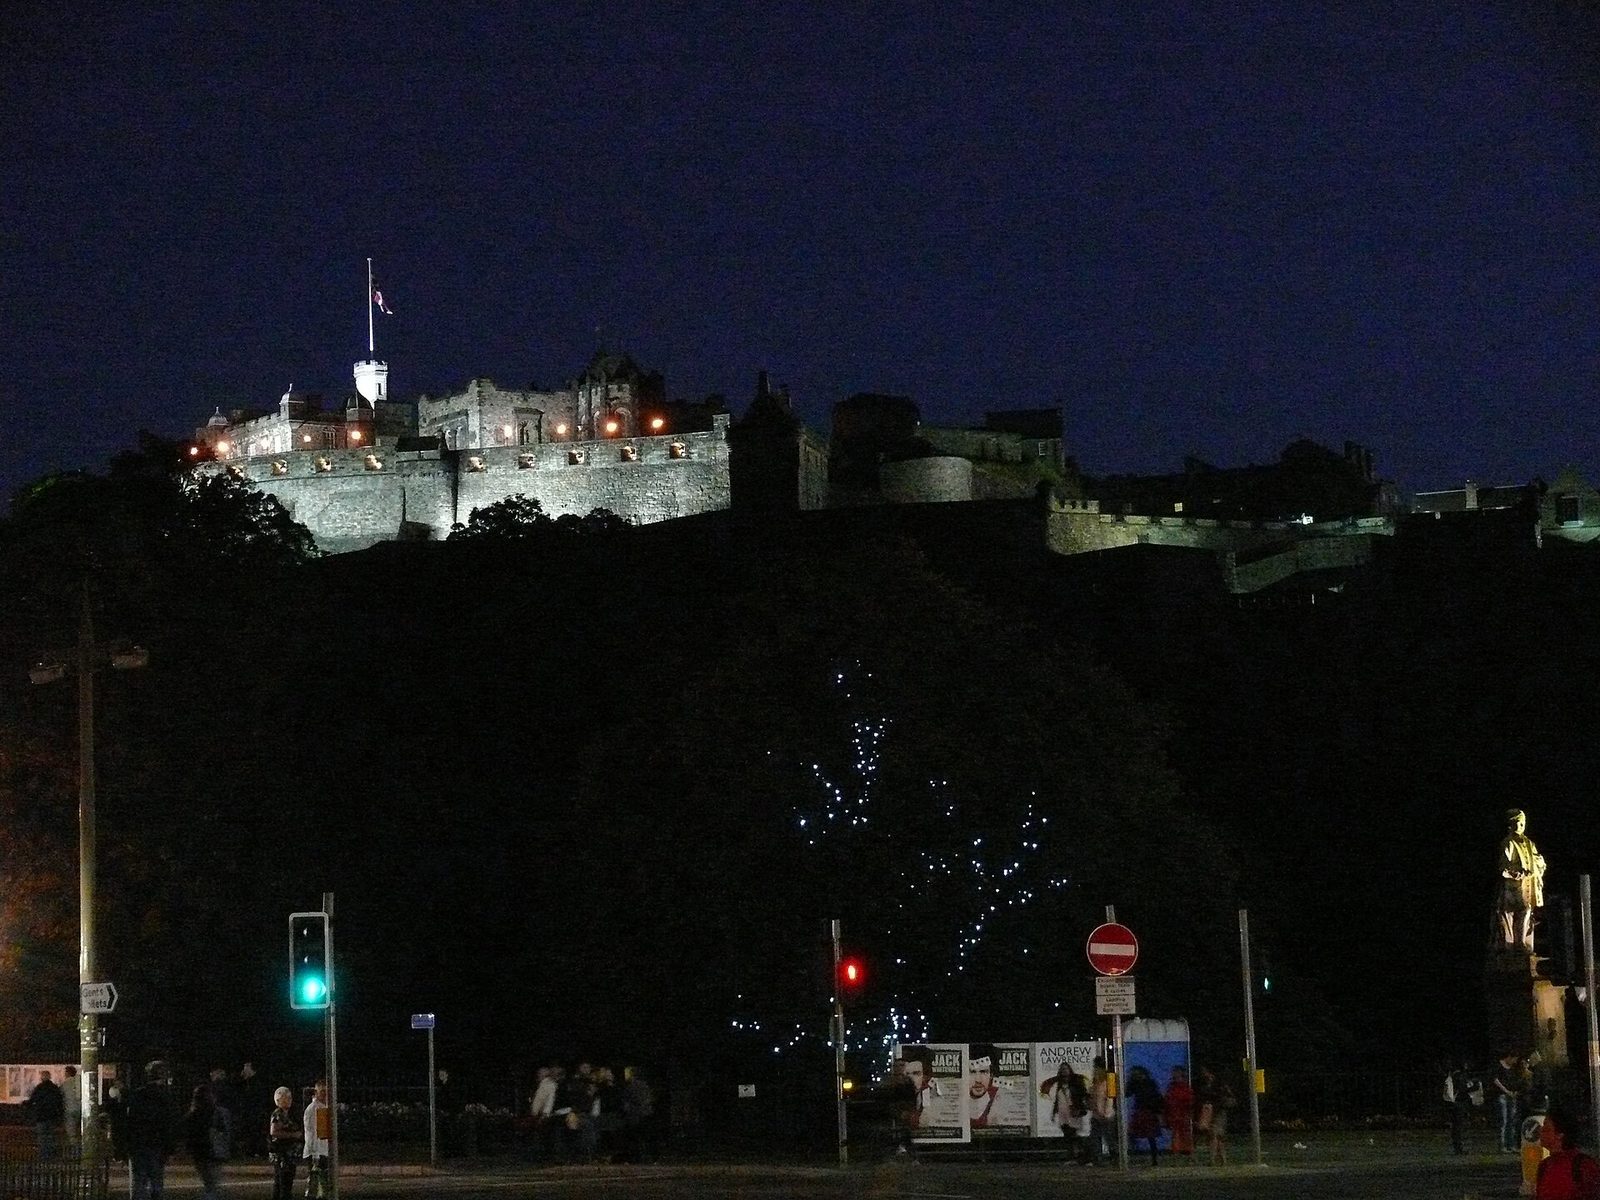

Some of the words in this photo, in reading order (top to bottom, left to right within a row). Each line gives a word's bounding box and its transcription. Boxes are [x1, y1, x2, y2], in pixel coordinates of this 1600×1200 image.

[1040, 1046, 1091, 1057] ANDREW
[931, 1053, 960, 1067] JACK
[998, 1052, 1028, 1065] JACK
[1041, 1056, 1091, 1064] LAWRENCE
